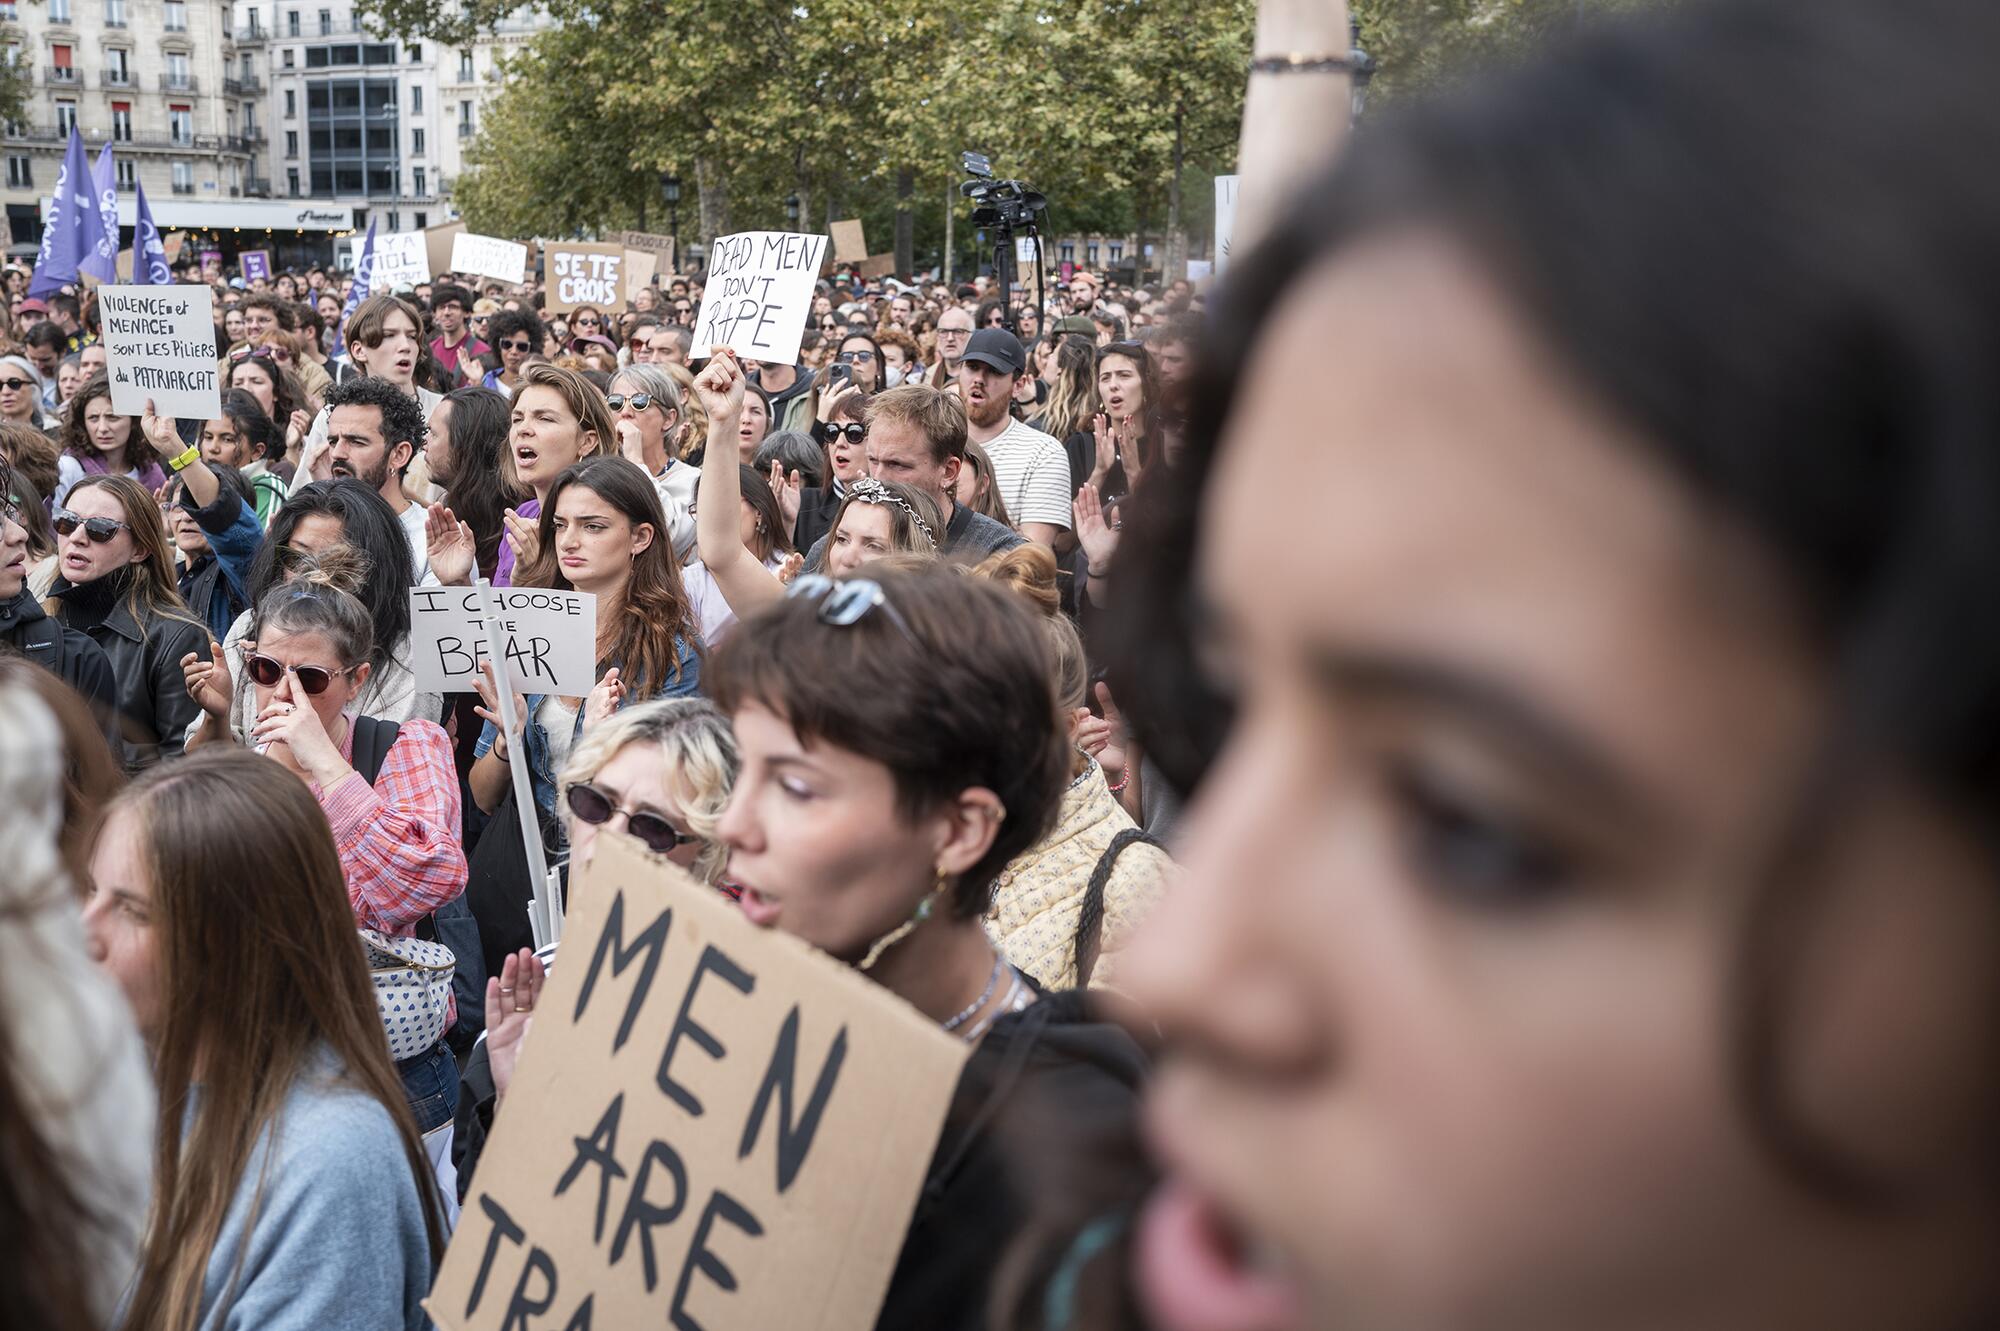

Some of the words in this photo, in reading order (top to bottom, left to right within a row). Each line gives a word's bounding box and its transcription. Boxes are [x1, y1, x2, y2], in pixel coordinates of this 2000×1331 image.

[554, 253, 587, 277] JE
[588, 254, 621, 281] TE
[711, 236, 753, 277] DEAD
[759, 234, 820, 271] MEN
[559, 278, 617, 305] CROIS
[723, 275, 775, 303] DON'T
[175, 300, 190, 315] et
[702, 299, 783, 347] RAPE
[146, 342, 170, 356] LES
[115, 367, 129, 383] du
[133, 366, 215, 391] PATRIARCAT
[413, 591, 449, 612] I
[437, 635, 558, 686] BEAR
[573, 888, 848, 1195] MEN
[553, 1091, 765, 1331] ARE
